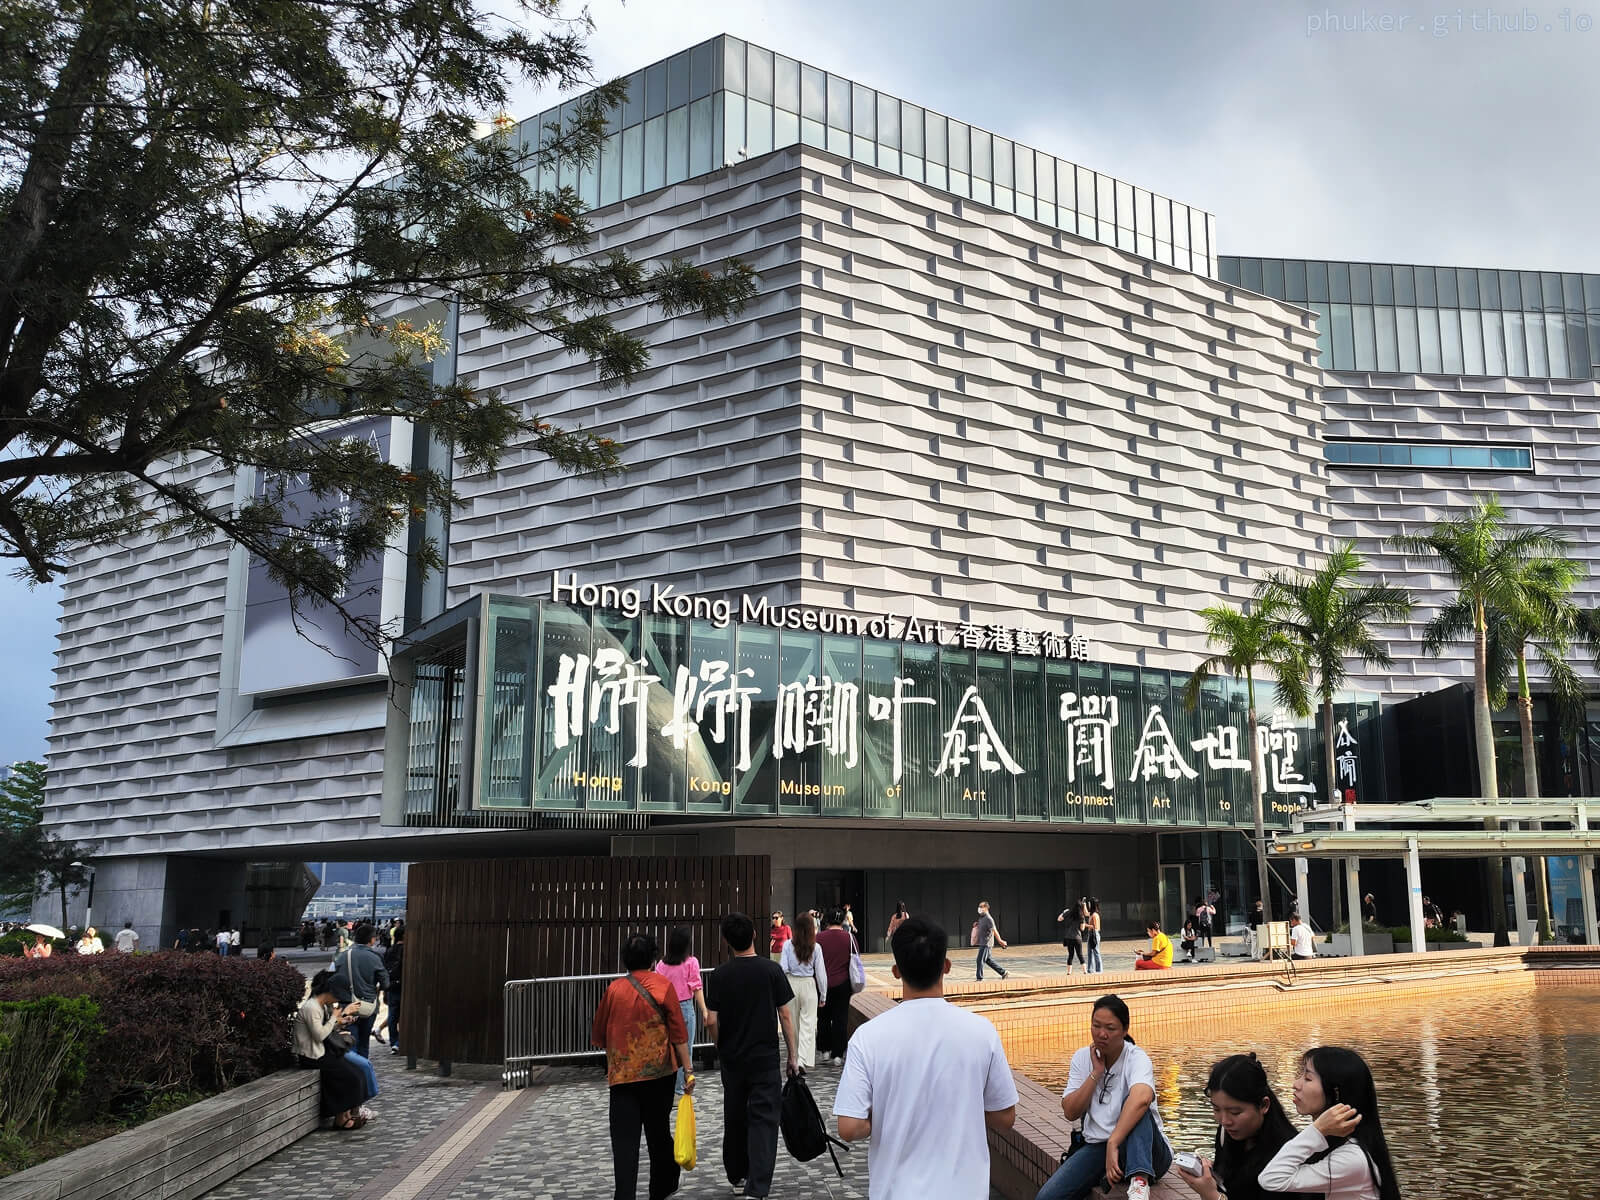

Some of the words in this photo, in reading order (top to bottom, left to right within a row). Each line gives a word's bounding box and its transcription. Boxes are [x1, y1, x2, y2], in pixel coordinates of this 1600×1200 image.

[552, 570, 640, 619] Hong
[652, 582, 731, 629] Kong
[741, 594, 859, 635] Museum
[869, 612, 898, 638] of
[905, 616, 946, 645] Art
[958, 620, 1091, 662] 香港藝術館
[573, 771, 623, 792] Hong
[689, 776, 731, 795] Kong
[780, 779, 846, 797] Museum
[886, 785, 902, 798] of
[962, 788, 986, 802] Art
[1066, 791, 1114, 807] Connect
[1152, 796, 1171, 809] Art
[1219, 799, 1231, 811] to
[1271, 801, 1302, 814] People
